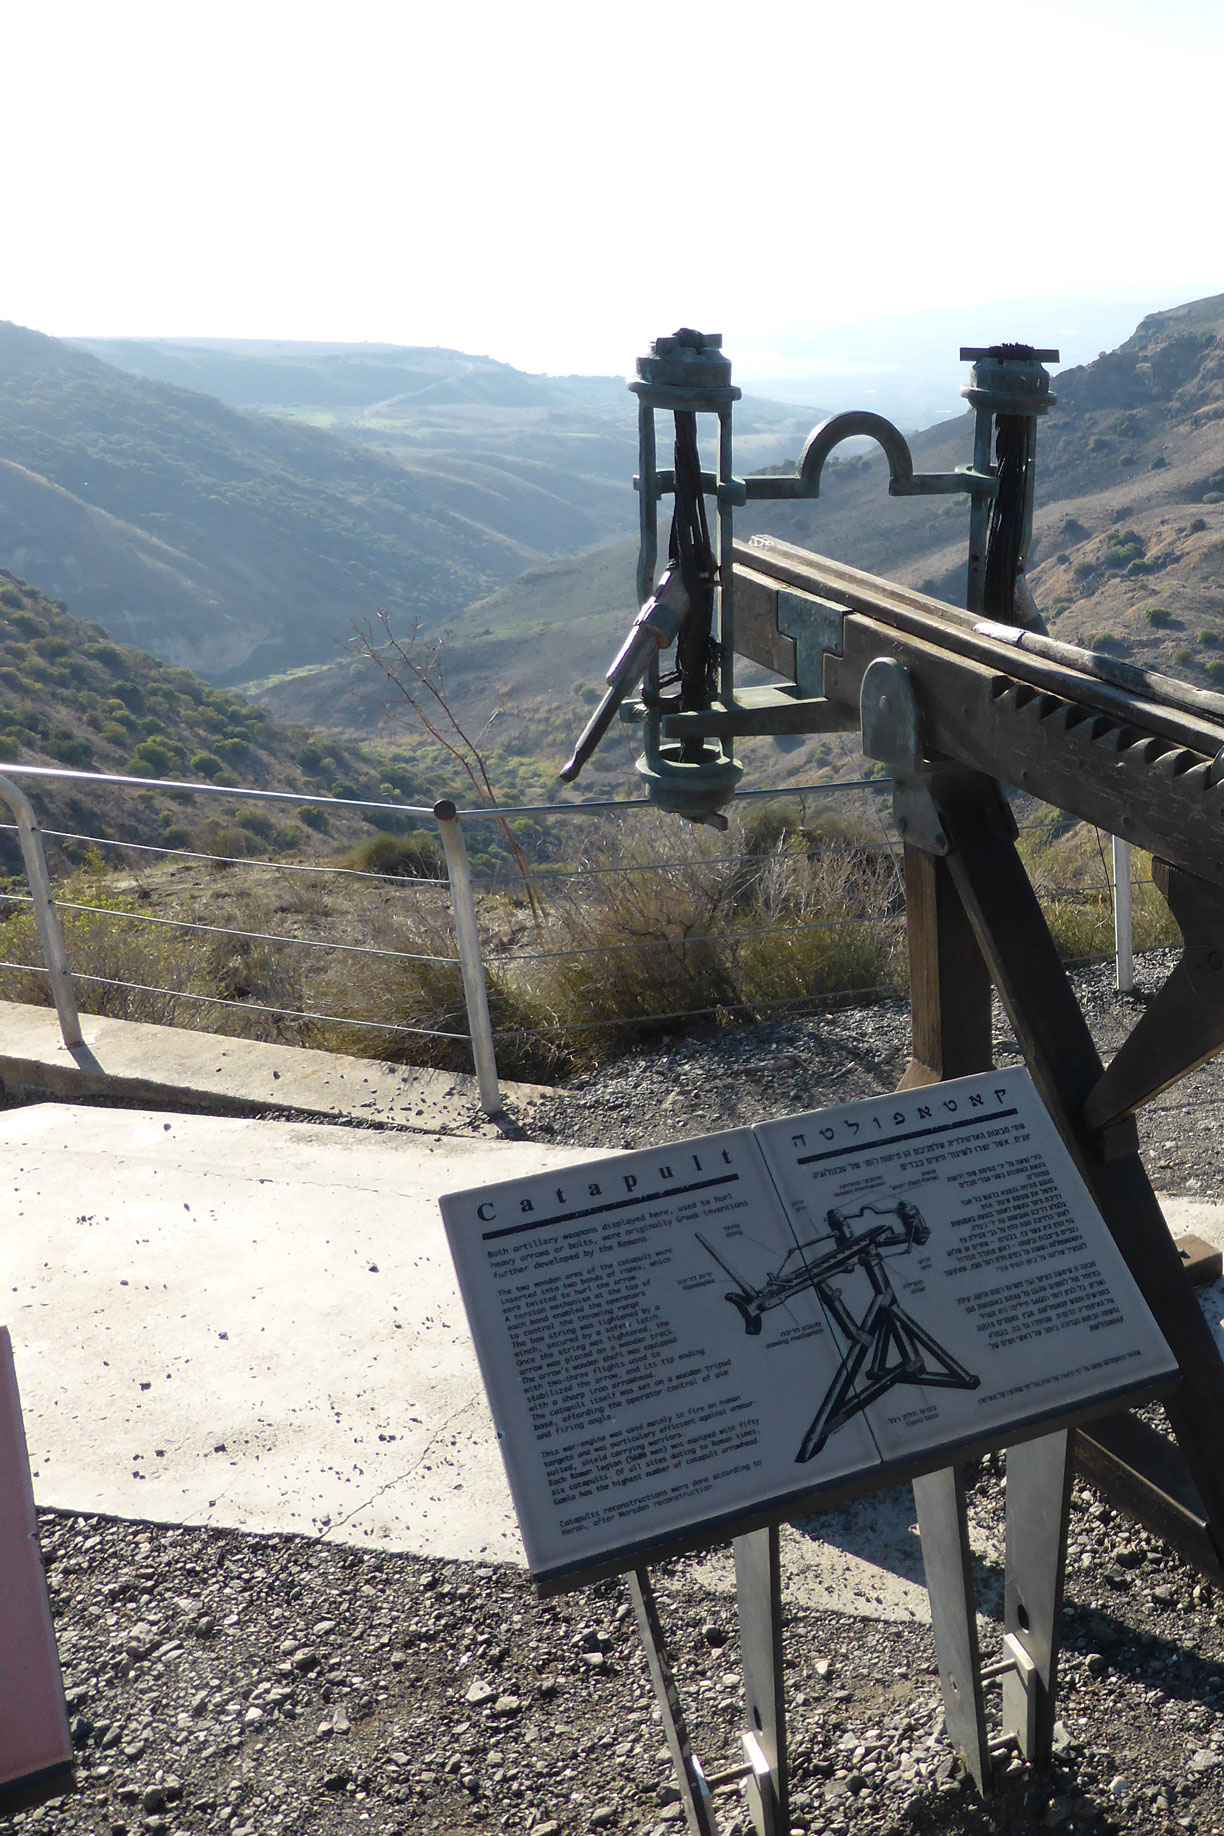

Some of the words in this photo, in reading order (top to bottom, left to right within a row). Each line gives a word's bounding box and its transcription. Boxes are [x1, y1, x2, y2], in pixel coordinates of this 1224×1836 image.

[790, 1087, 1006, 1148] קאטאפולטה
[476, 1148, 732, 1222] Catapult
[486, 1246, 509, 1259] Both
[511, 1235, 559, 1253] artillery
[600, 1212, 646, 1231] displayed
[647, 1208, 673, 1219] here,
[676, 1200, 698, 1212] used
[699, 1198, 711, 1207] to
[712, 1192, 733, 1203] hurl
[489, 1257, 516, 1268] heavy
[553, 1244, 564, 1253] or
[566, 1238, 598, 1250] bolts,
[600, 1231, 622, 1241] were
[624, 1218, 672, 1236] originally
[674, 1210, 700, 1223] Greek
[702, 1199, 749, 1216] inventions
[492, 1264, 529, 1279] further
[532, 1250, 580, 1270] developed
[582, 1248, 594, 1258] by
[597, 1244, 614, 1253] the
[496, 1288, 512, 1296] The
[585, 1265, 595, 1275] of
[599, 1262, 614, 1271] the
[616, 1252, 652, 1267] catapult
[539, 1285, 560, 1295] into
[605, 1268, 616, 1278] of
[560, 1291, 571, 1299] to
[572, 1284, 592, 1296] hurl
[595, 1281, 611, 1290] the
[587, 1301, 603, 1310] the
[593, 1291, 604, 1299] at
[606, 1286, 622, 1296] the
[624, 1282, 639, 1291] top
[641, 1277, 650, 1287] of
[508, 1332, 520, 1340] to
[522, 1321, 555, 1337] control
[558, 1317, 574, 1327] the
[510, 1339, 527, 1348] The
[639, 1306, 651, 1315] by
[514, 1356, 536, 1367] Once
[538, 1351, 554, 1361] the
[654, 1320, 669, 1329] the
[580, 1331, 592, 1340] by
[520, 1375, 536, 1385] The
[601, 1350, 625, 1363] shaft
[522, 1382, 544, 1394] with
[592, 1360, 626, 1375] flights
[627, 1352, 648, 1365] used
[650, 1350, 661, 1359] to
[525, 1383, 574, 1403] stabilized
[575, 1379, 591, 1389] the
[642, 1360, 658, 1370] its
[660, 1355, 675, 1365] tip
[677, 1347, 706, 1360] ending
[563, 1348, 594, 1365] placed
[527, 1400, 549, 1412] with
[560, 1391, 586, 1403] sharp
[588, 1384, 609, 1396] iron
[530, 1412, 546, 1421] The
[548, 1400, 586, 1417] catapult
[636, 1381, 651, 1392] set
[703, 1357, 732, 1372] tripod
[560, 1405, 605, 1423] affording
[607, 1400, 623, 1410] the
[665, 1376, 698, 1393] control
[701, 1372, 710, 1383] of
[539, 1448, 560, 1459] This
[674, 1411, 685, 1419] to
[686, 1405, 705, 1415] fire
[554, 1421, 585, 1435] firing
[586, 1413, 616, 1426] angle.
[594, 1459, 623, 1472] legion
[717, 1424, 737, 1435] with
[738, 1417, 759, 1428] fifty
[542, 1453, 575, 1468] targets
[595, 1483, 610, 1492] the
[672, 1458, 682, 1469] of
[685, 1449, 718, 1465] catapult
[614, 1466, 625, 1477] Of
[627, 1462, 642, 1473] all
[644, 1455, 668, 1468] sites
[698, 1443, 709, 1451] to
[558, 1509, 600, 1528] Catapults
[602, 1488, 668, 1514] reconstructions
[752, 1459, 762, 1467] to
[592, 1513, 615, 1527] after
